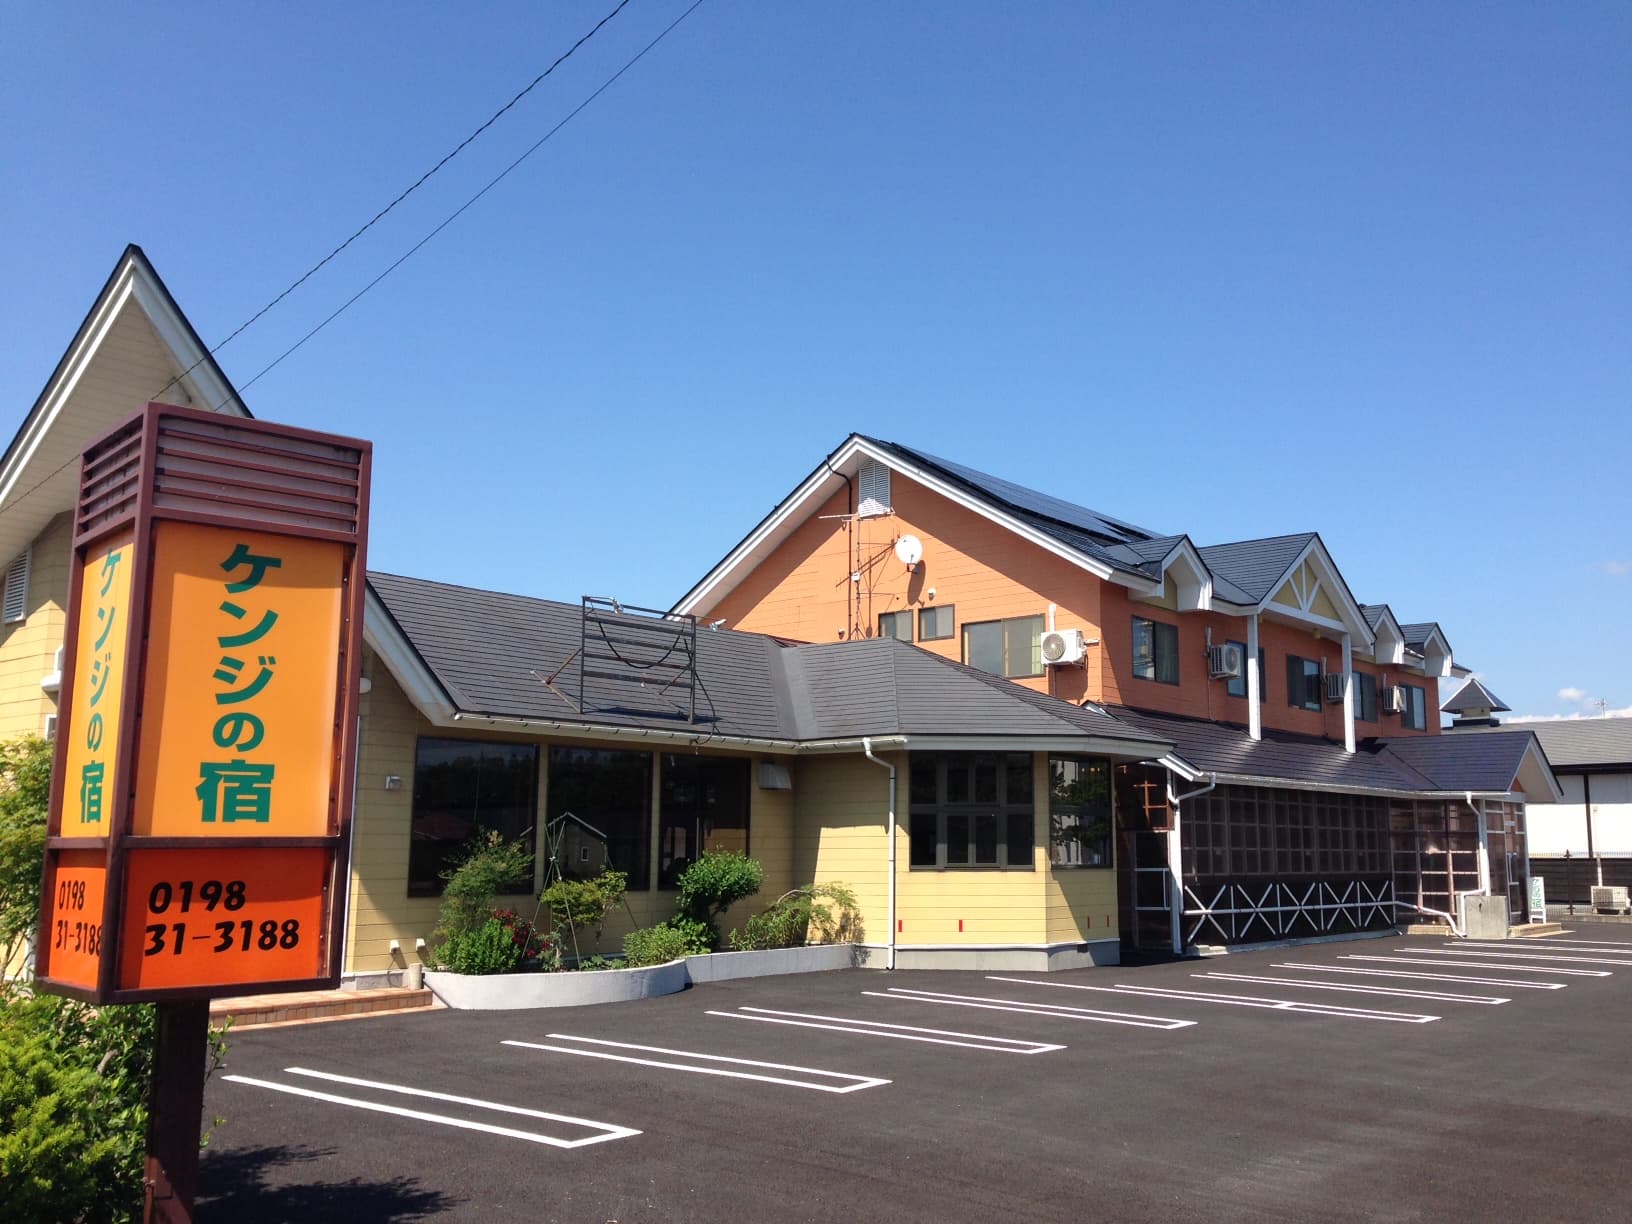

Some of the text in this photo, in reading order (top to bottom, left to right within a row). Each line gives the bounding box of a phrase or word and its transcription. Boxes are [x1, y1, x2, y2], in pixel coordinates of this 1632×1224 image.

[80, 547, 122, 823] ケンジの宿
[196, 544, 282, 823] ケンジの宿
[59, 880, 85, 911] 0198
[148, 880, 246, 914] 0198
[144, 919, 300, 957] 31-3188
